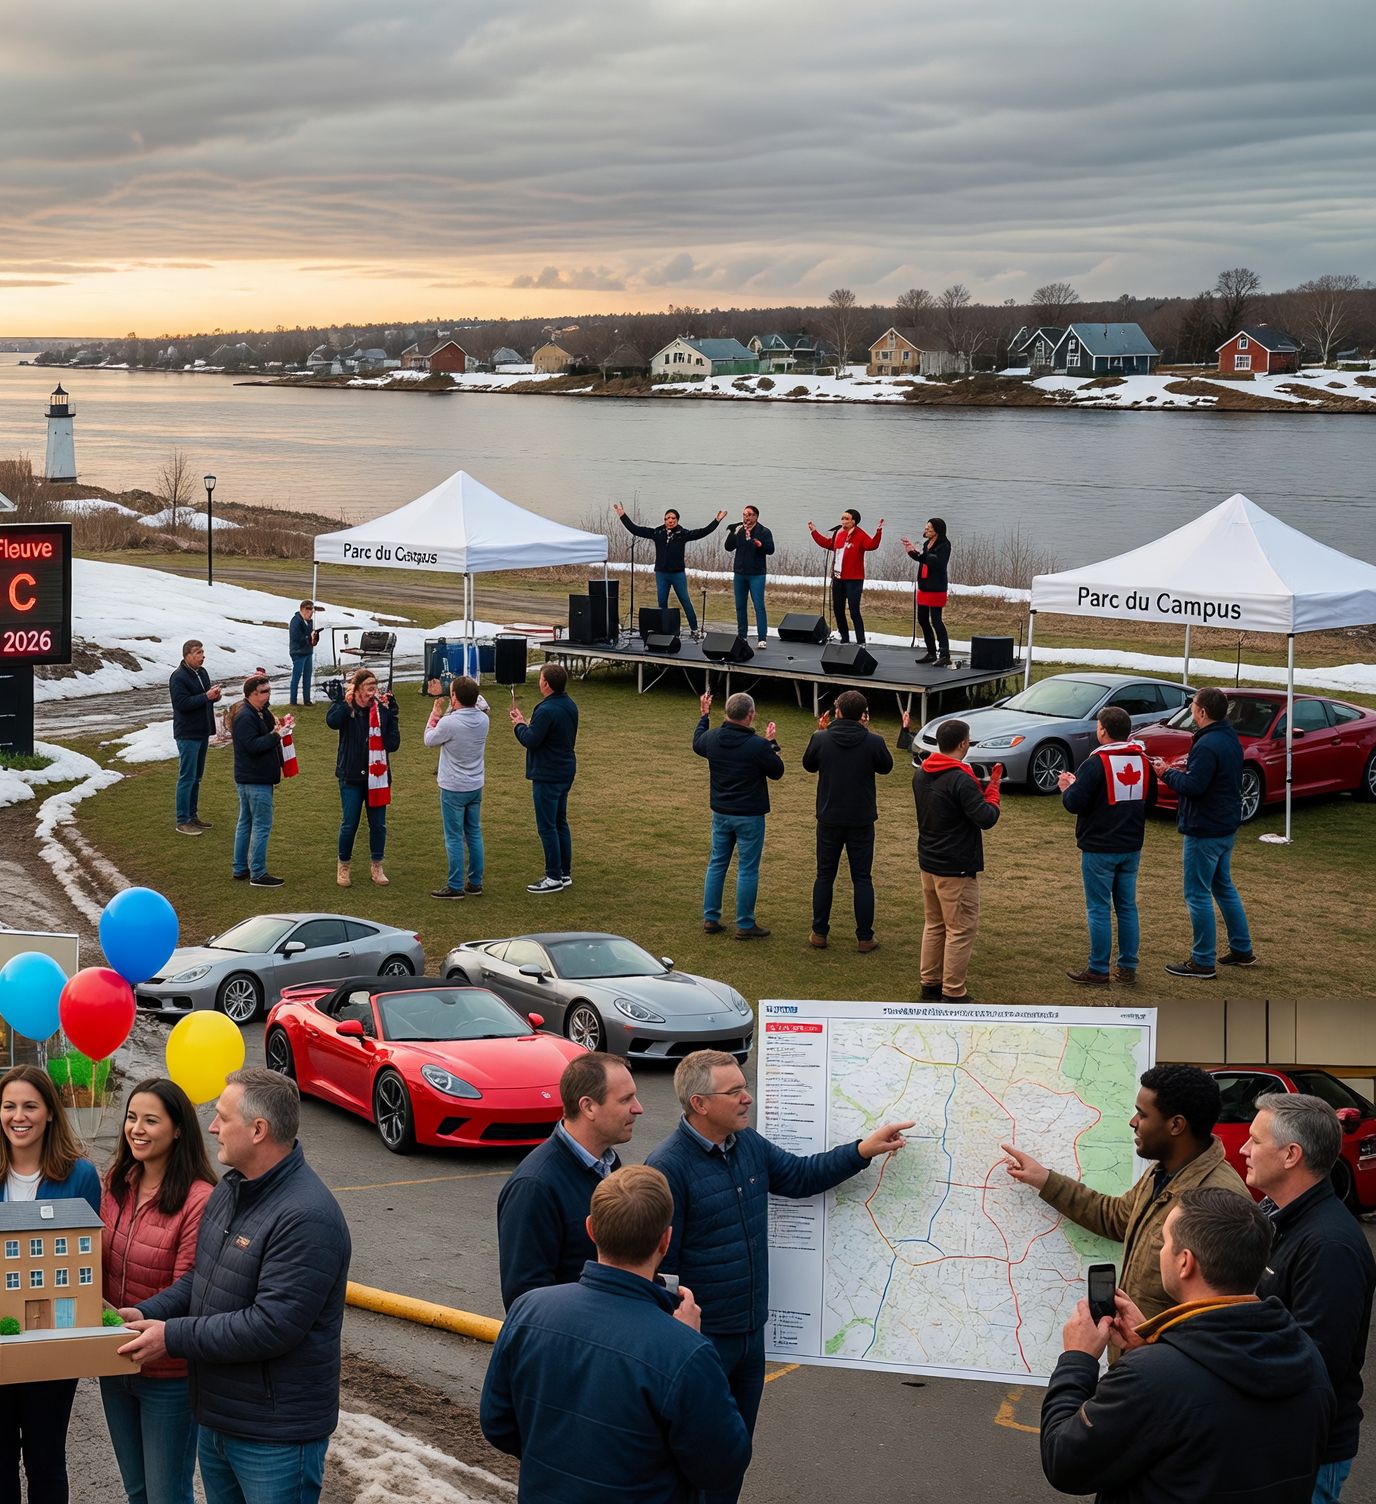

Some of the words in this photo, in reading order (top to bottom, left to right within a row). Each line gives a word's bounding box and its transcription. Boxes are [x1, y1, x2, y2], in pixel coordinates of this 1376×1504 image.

[343, 542, 372, 560] Parc
[375, 545, 392, 561] du
[8, 573, 37, 612] C
[1077, 586, 1120, 609] Parc
[1125, 591, 1150, 612] du
[1156, 592, 1242, 623] Campus
[3, 630, 52, 653] 2026
